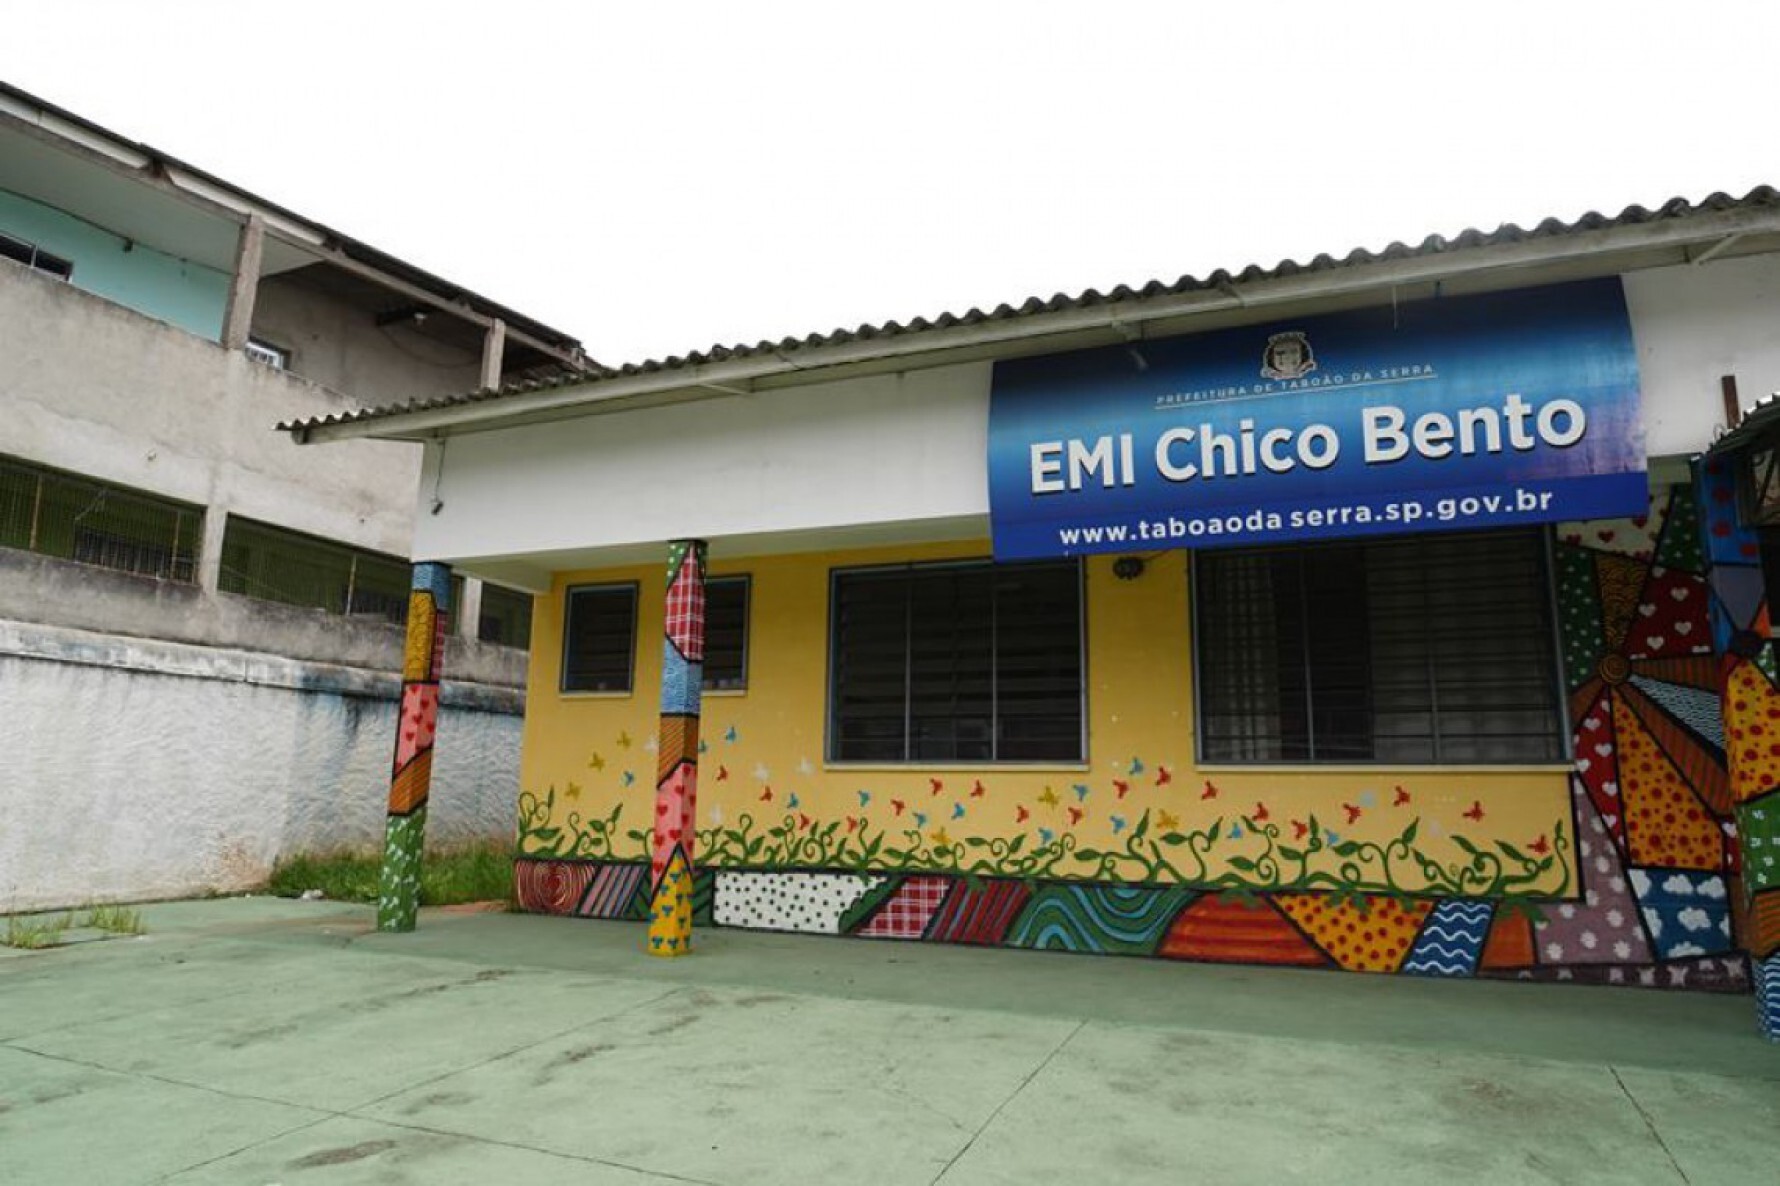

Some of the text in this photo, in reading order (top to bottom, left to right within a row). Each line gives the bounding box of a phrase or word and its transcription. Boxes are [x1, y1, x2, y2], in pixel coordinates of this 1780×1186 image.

[1156, 386, 1247, 404] PREFEITURA
[1253, 383, 1273, 395] DE
[1351, 371, 1373, 382] DA
[1379, 364, 1433, 379] SERRA
[1030, 394, 1587, 494] EMI Chico Bento
